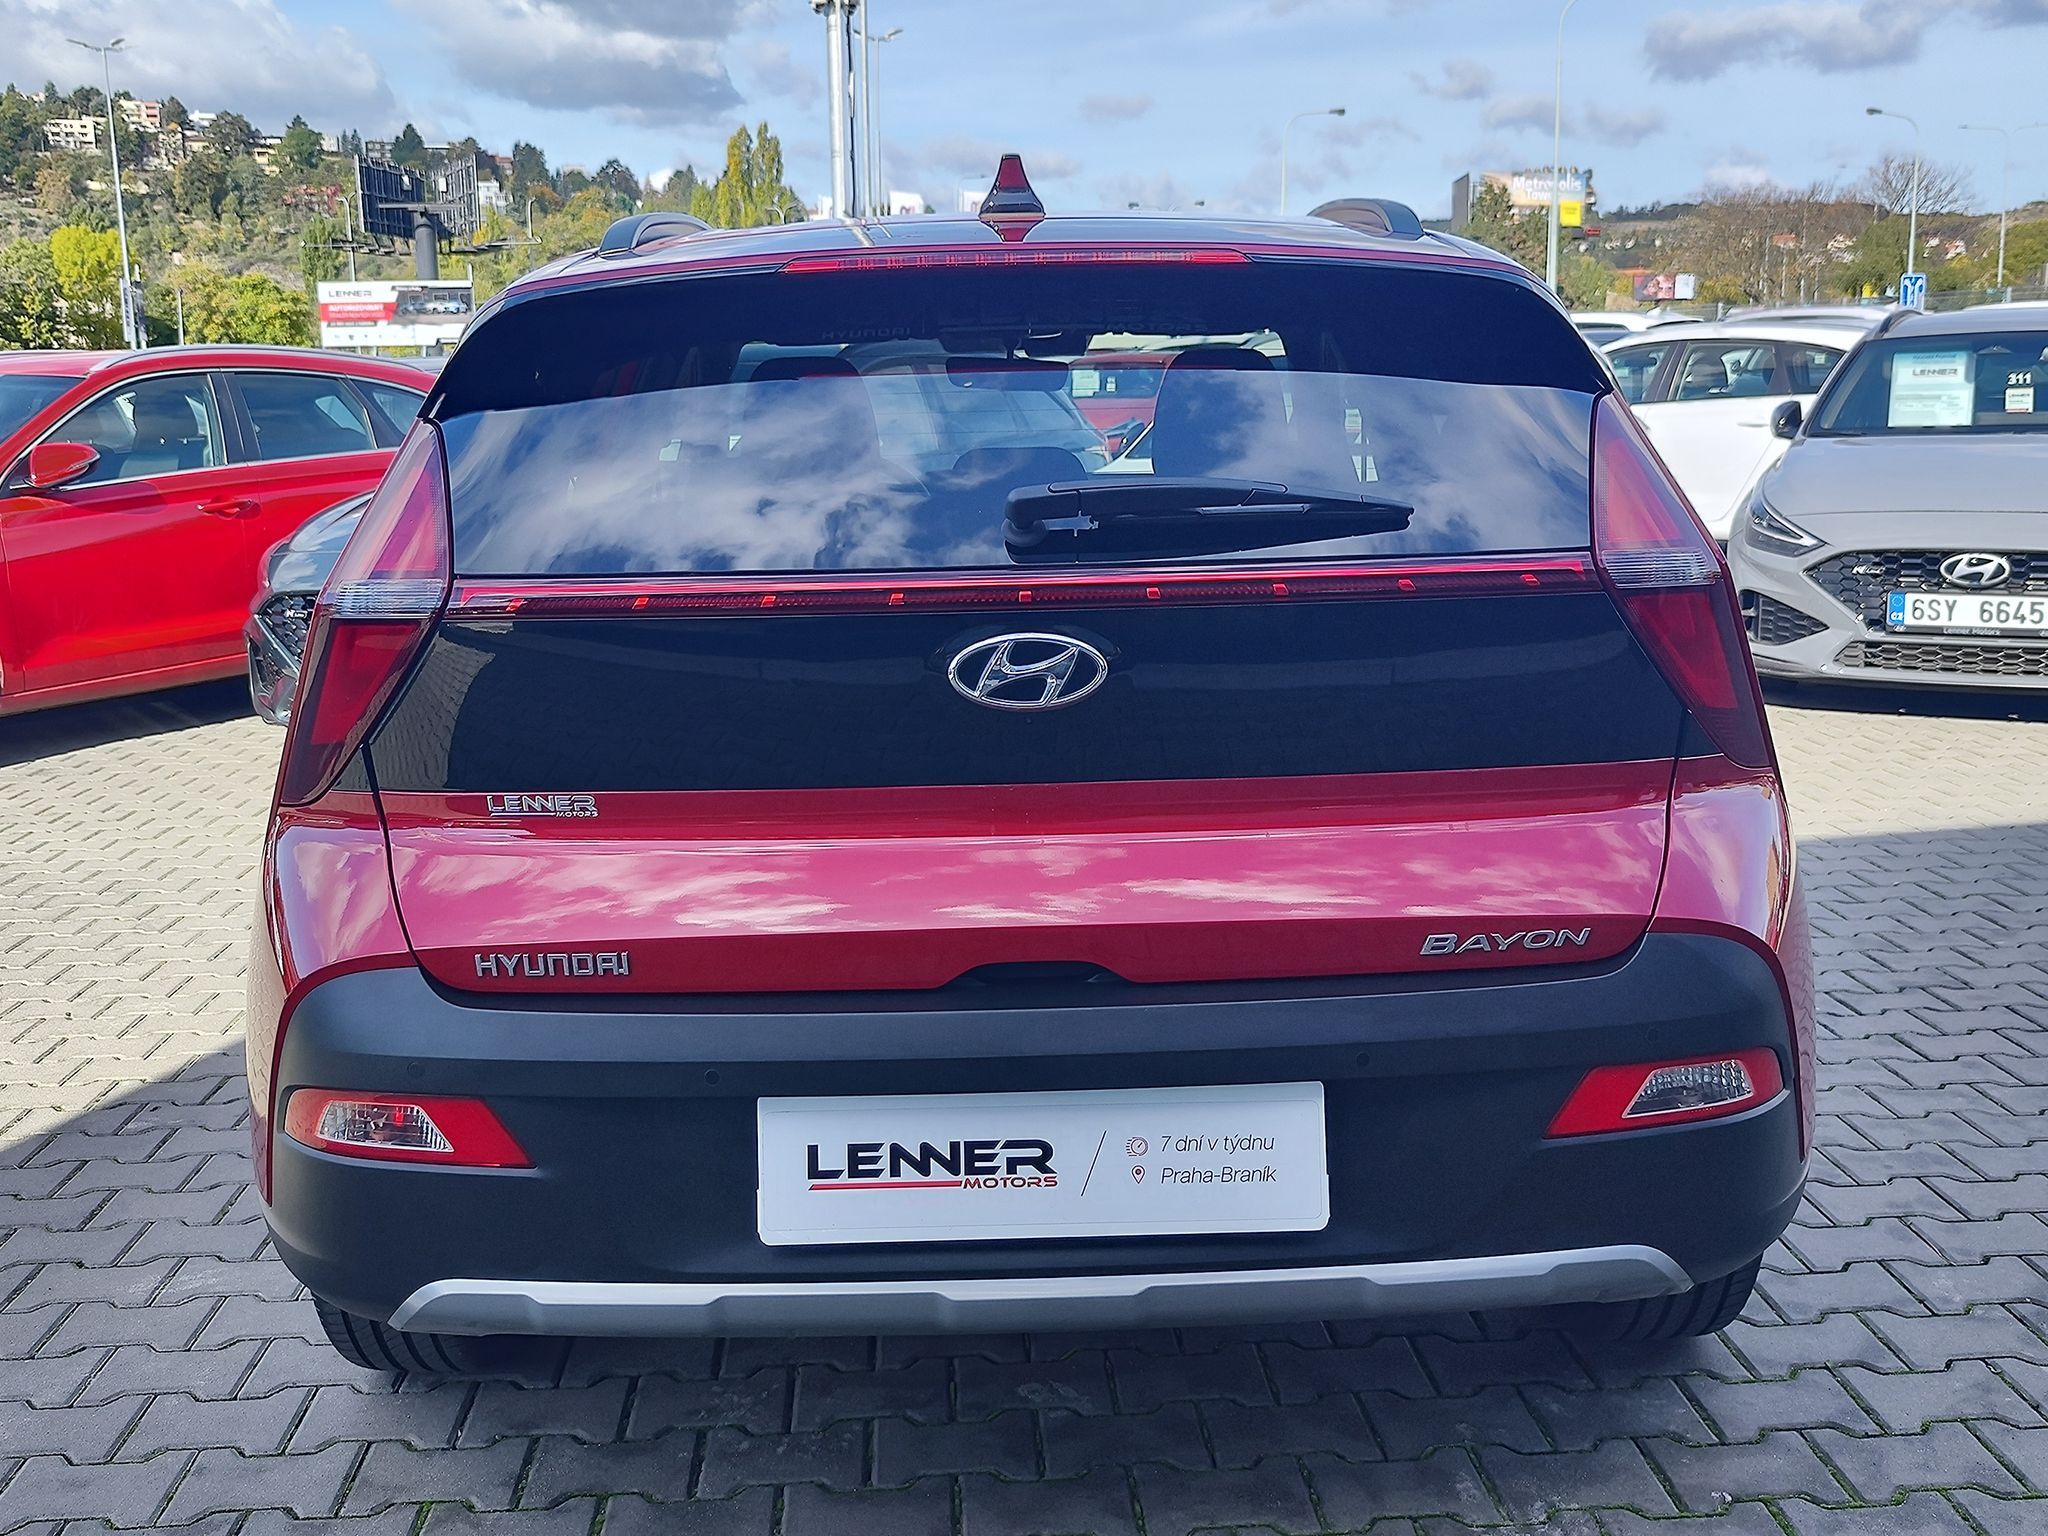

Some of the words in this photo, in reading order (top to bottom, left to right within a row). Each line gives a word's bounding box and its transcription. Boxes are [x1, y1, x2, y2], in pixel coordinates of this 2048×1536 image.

[1513, 174, 1582, 192] Metroolis
[2007, 371, 2033, 385] 311
[1912, 599, 1957, 621] 6SY
[1980, 600, 2045, 624] 6645
[486, 795, 598, 811] LENNER
[1420, 928, 1592, 955] BAYON
[475, 952, 629, 977] HYUNDAI
[1161, 1135, 1172, 1152] 7
[1175, 1134, 1204, 1152] dní
[1207, 1138, 1219, 1151] v
[1223, 1134, 1275, 1155] týdnu
[807, 1140, 1057, 1180] LENNER
[963, 1176, 1058, 1190] MOTORS
[1161, 1166, 1277, 1184] Praha-Braník
